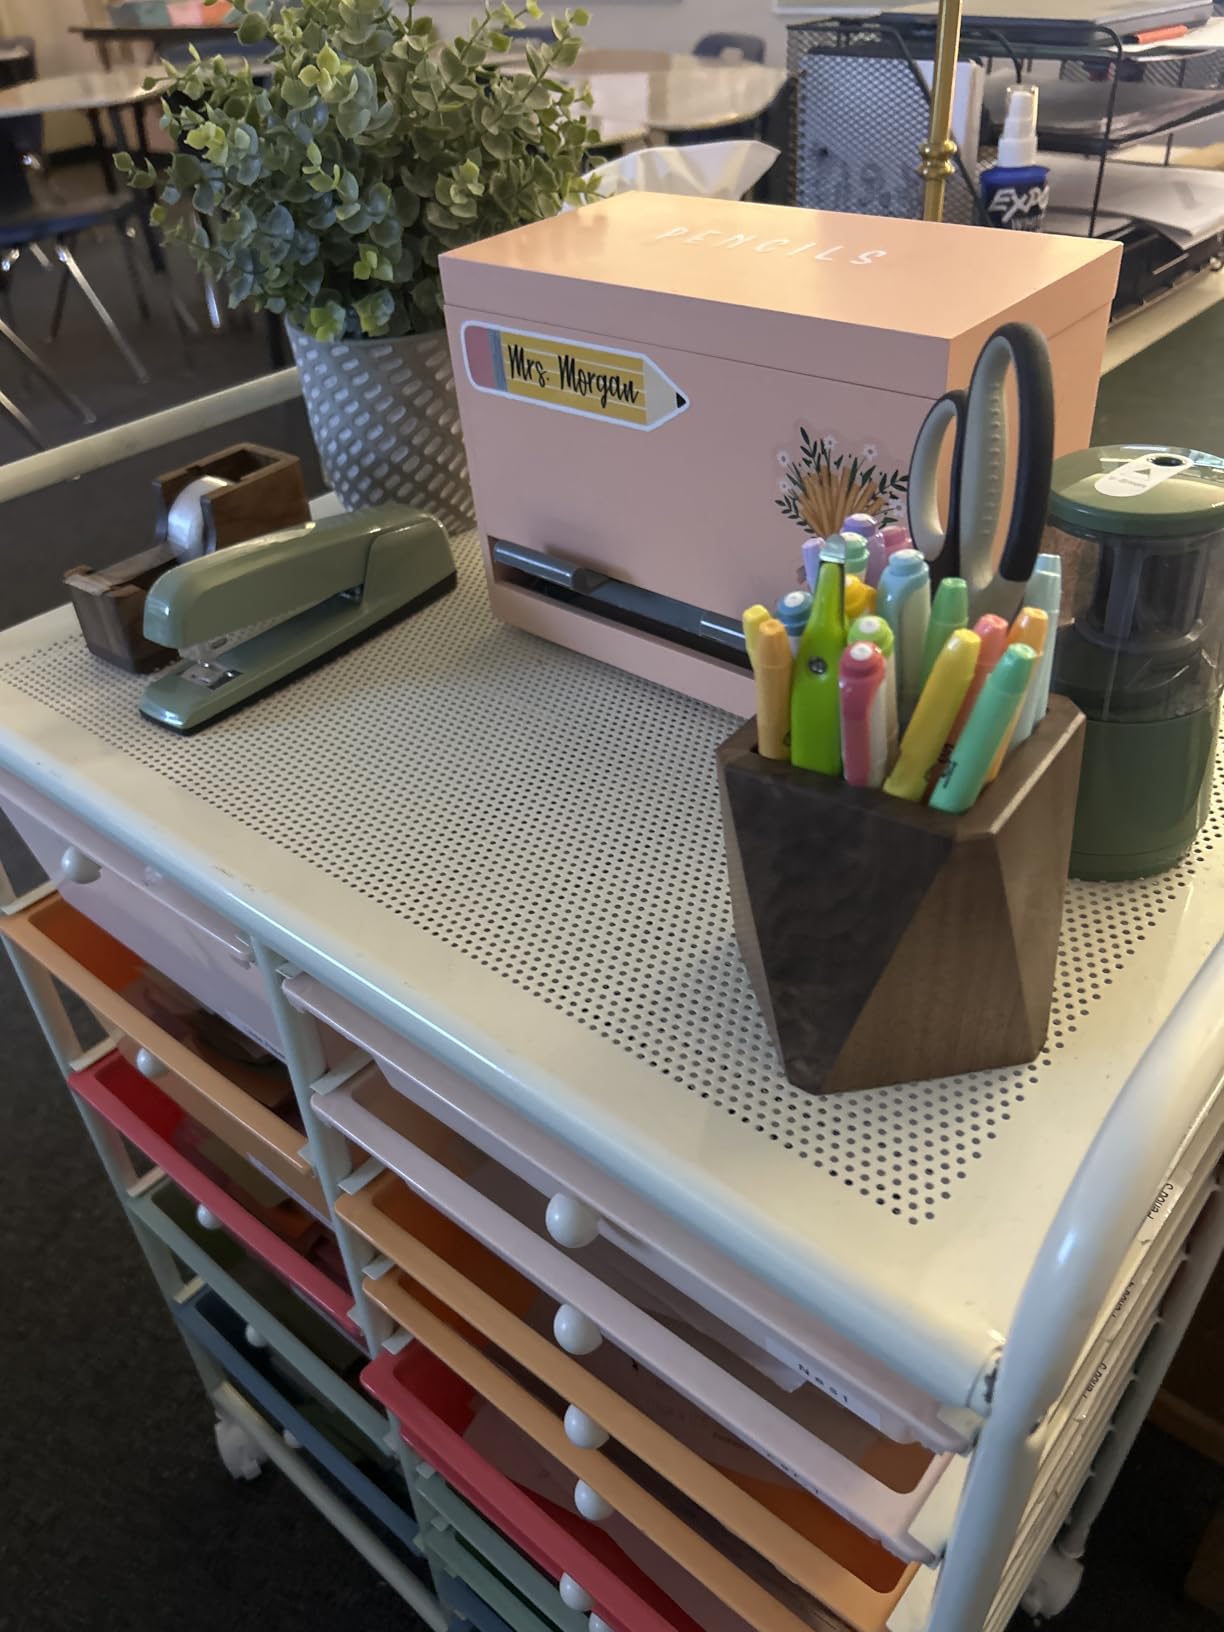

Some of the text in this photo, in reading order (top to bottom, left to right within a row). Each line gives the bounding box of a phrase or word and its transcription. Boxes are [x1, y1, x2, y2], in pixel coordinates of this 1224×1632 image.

[656, 227, 887, 264] PENCILS
[507, 344, 639, 408] Mrs. Morgan
